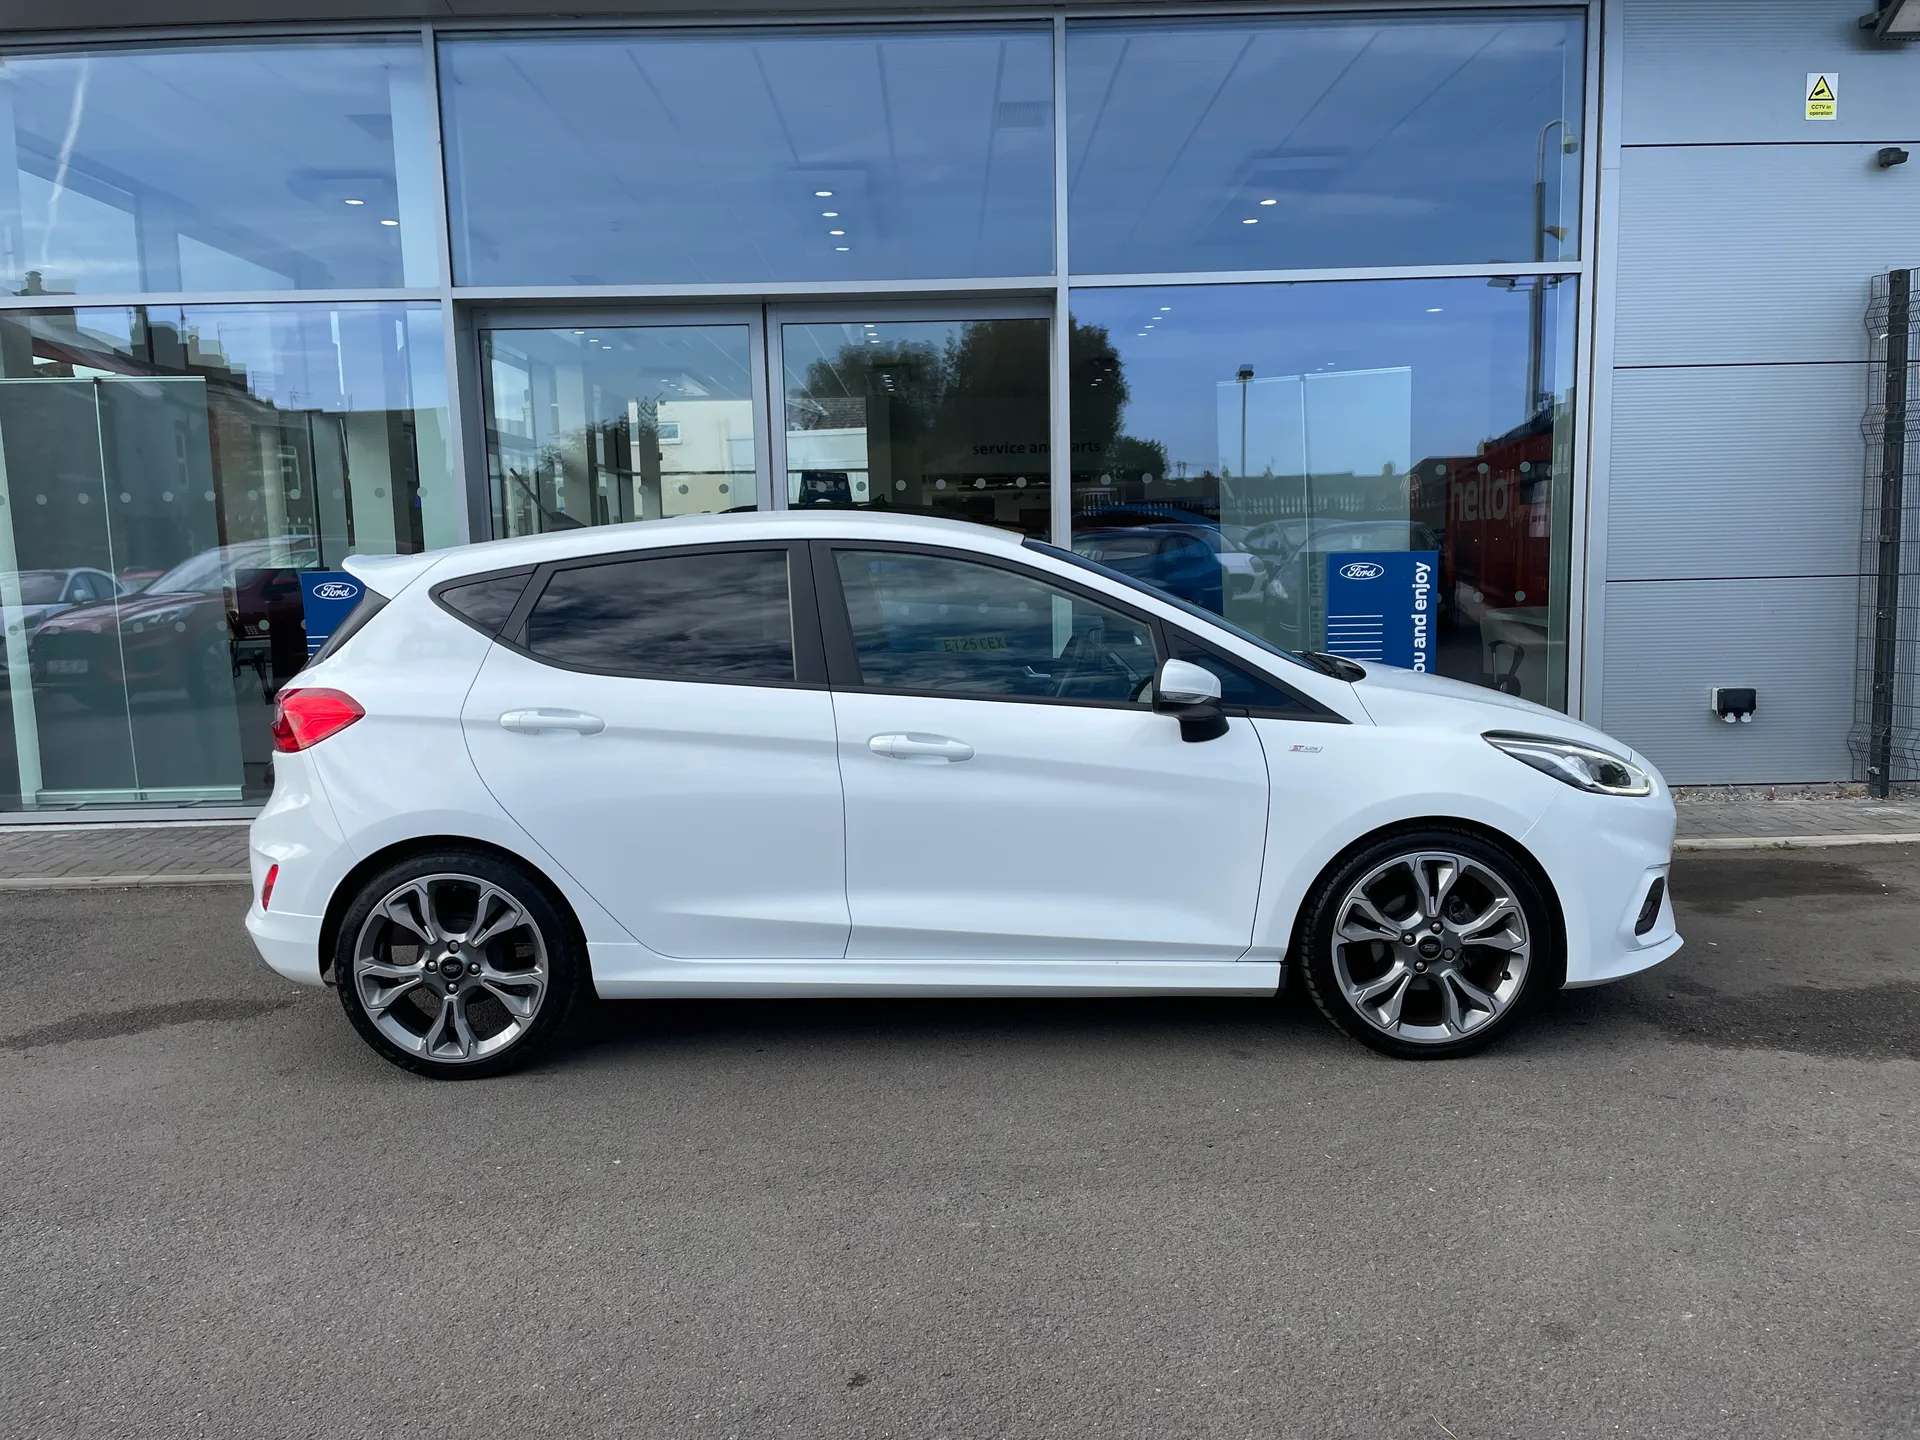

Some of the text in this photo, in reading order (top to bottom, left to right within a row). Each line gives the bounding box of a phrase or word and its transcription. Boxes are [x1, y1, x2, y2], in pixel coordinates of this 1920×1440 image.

[972, 441, 1101, 456] service an arts
[1450, 474, 1508, 520] hello
[1347, 564, 1377, 577] Ford
[320, 584, 350, 597] Ford
[1410, 561, 1431, 673] ou and enjoy
